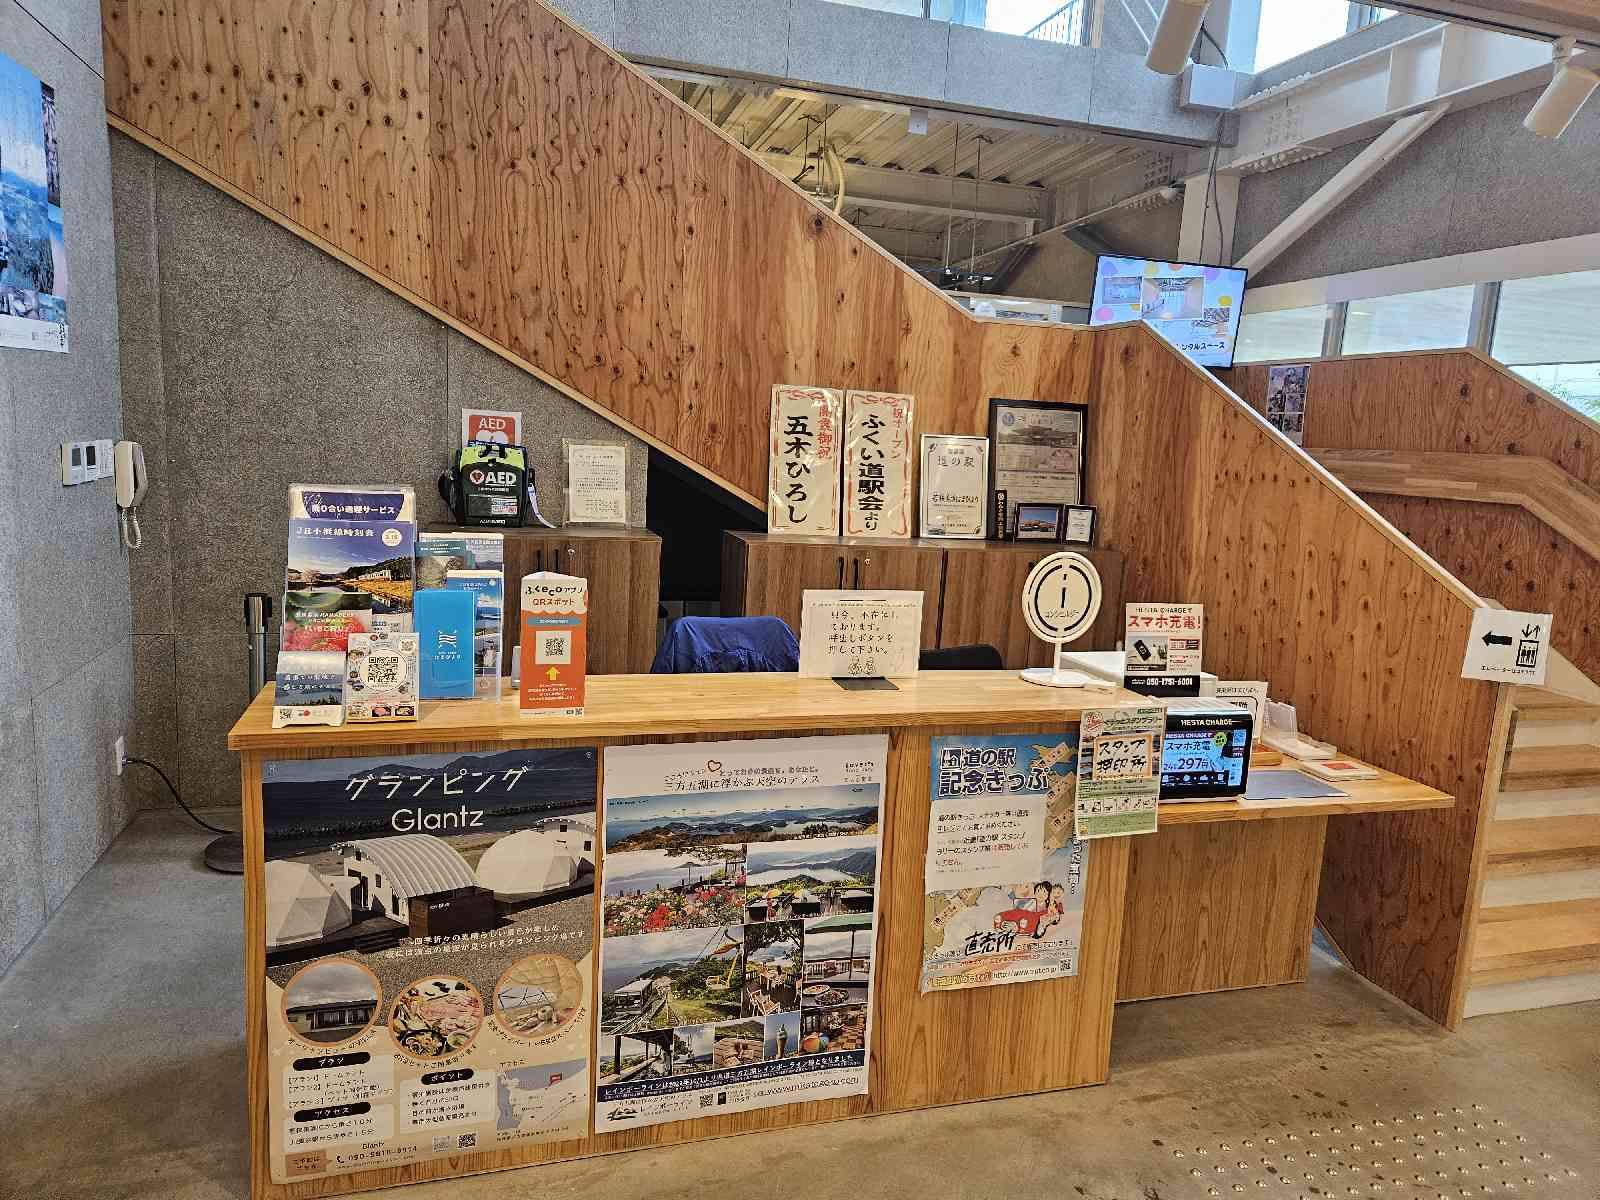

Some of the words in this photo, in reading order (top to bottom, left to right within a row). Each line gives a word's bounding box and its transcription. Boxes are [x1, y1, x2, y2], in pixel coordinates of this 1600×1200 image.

[479, 417, 506, 430] AED
[485, 471, 517, 485] AED
[783, 415, 814, 524] 五木ひろし
[857, 414, 886, 531] ふくい道駅会より
[532, 598, 577, 607] QRスポット
[962, 748, 1017, 768] 道の駅
[1099, 739, 1147, 755] スタンプ
[345, 767, 529, 801] グランピング
[938, 767, 1050, 796] 記念きっぷ
[391, 805, 484, 832] Glantz
[964, 930, 1017, 956] 直売所
